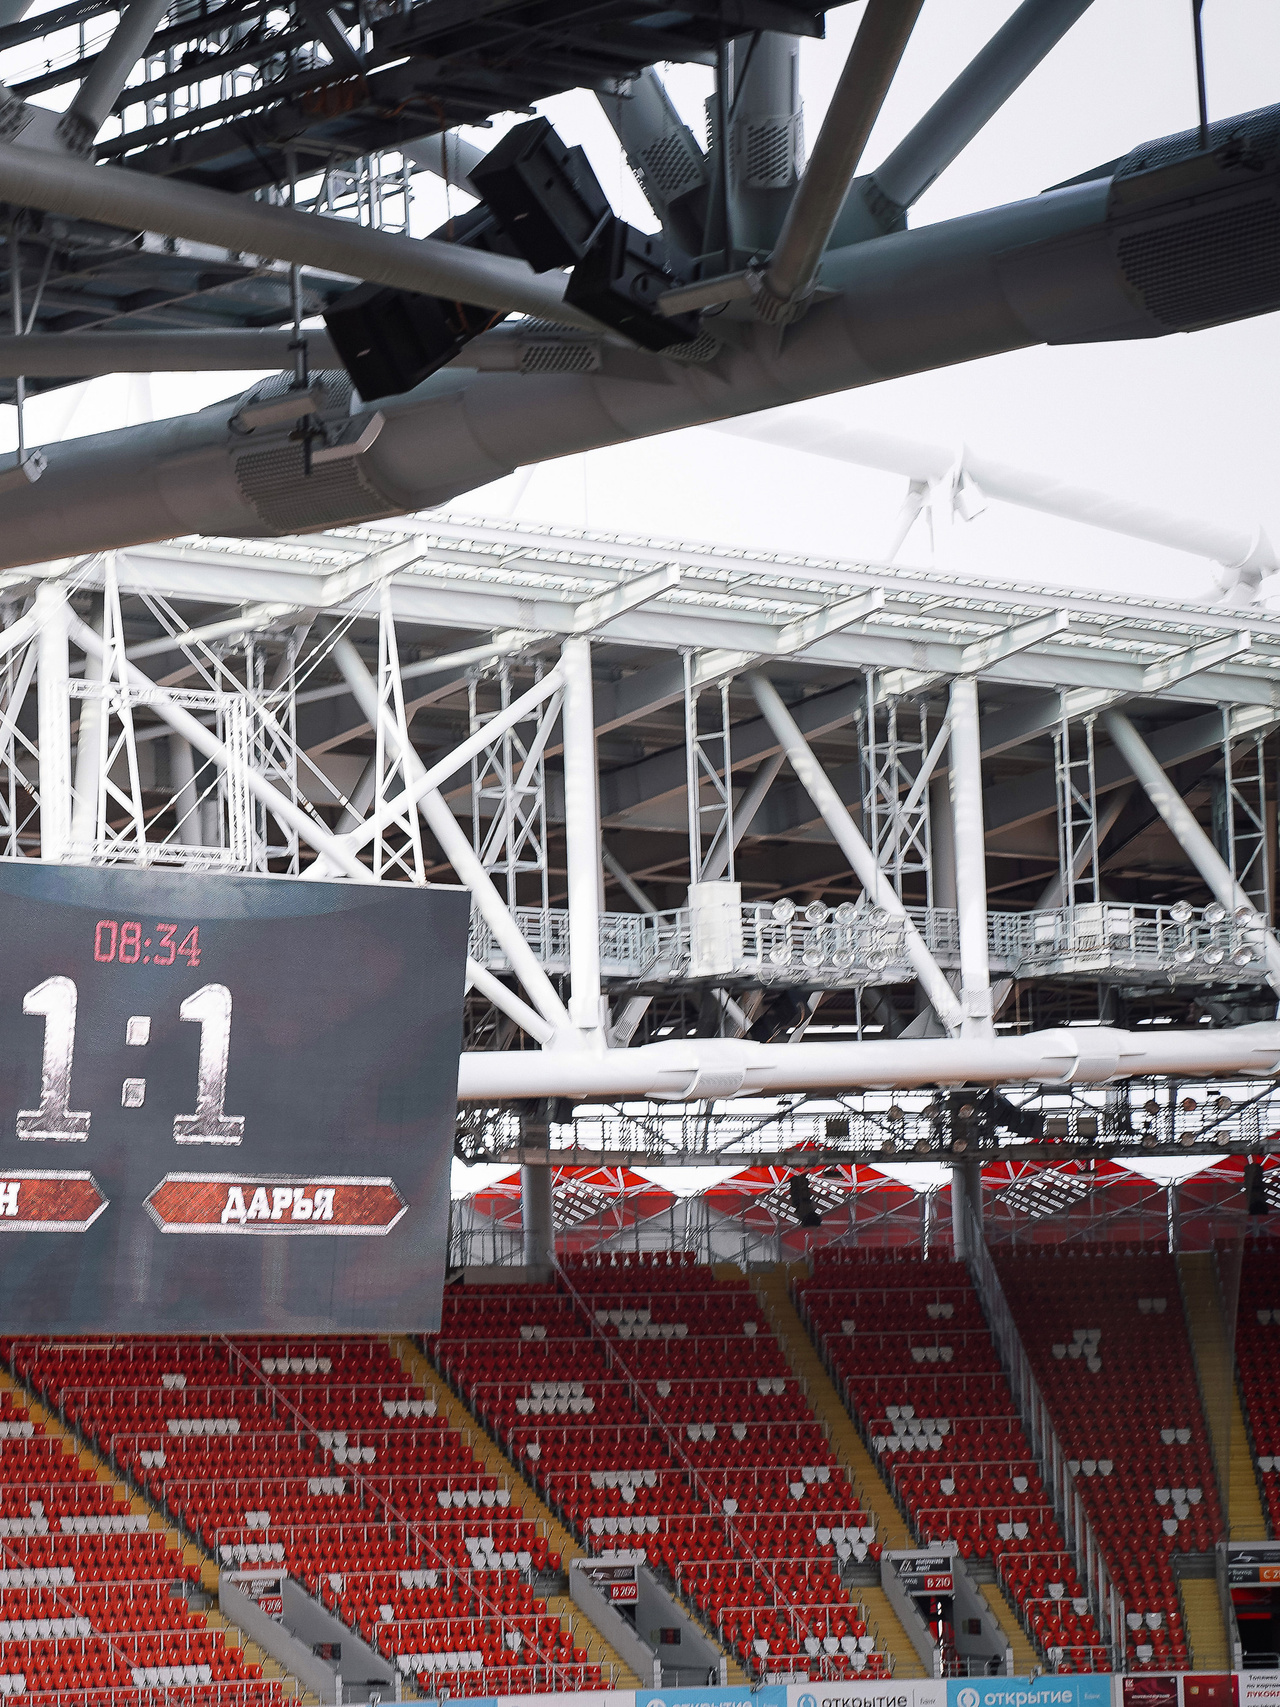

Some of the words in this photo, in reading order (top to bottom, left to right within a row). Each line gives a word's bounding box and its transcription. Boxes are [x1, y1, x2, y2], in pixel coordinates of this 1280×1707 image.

[93, 919, 202, 967] 08:34
[221, 1186, 336, 1225] ДАРЬЯ
[935, 1576, 951, 1588] 210
[821, 1695, 908, 1707] открытие
[984, 1689, 1073, 1707] открытие
